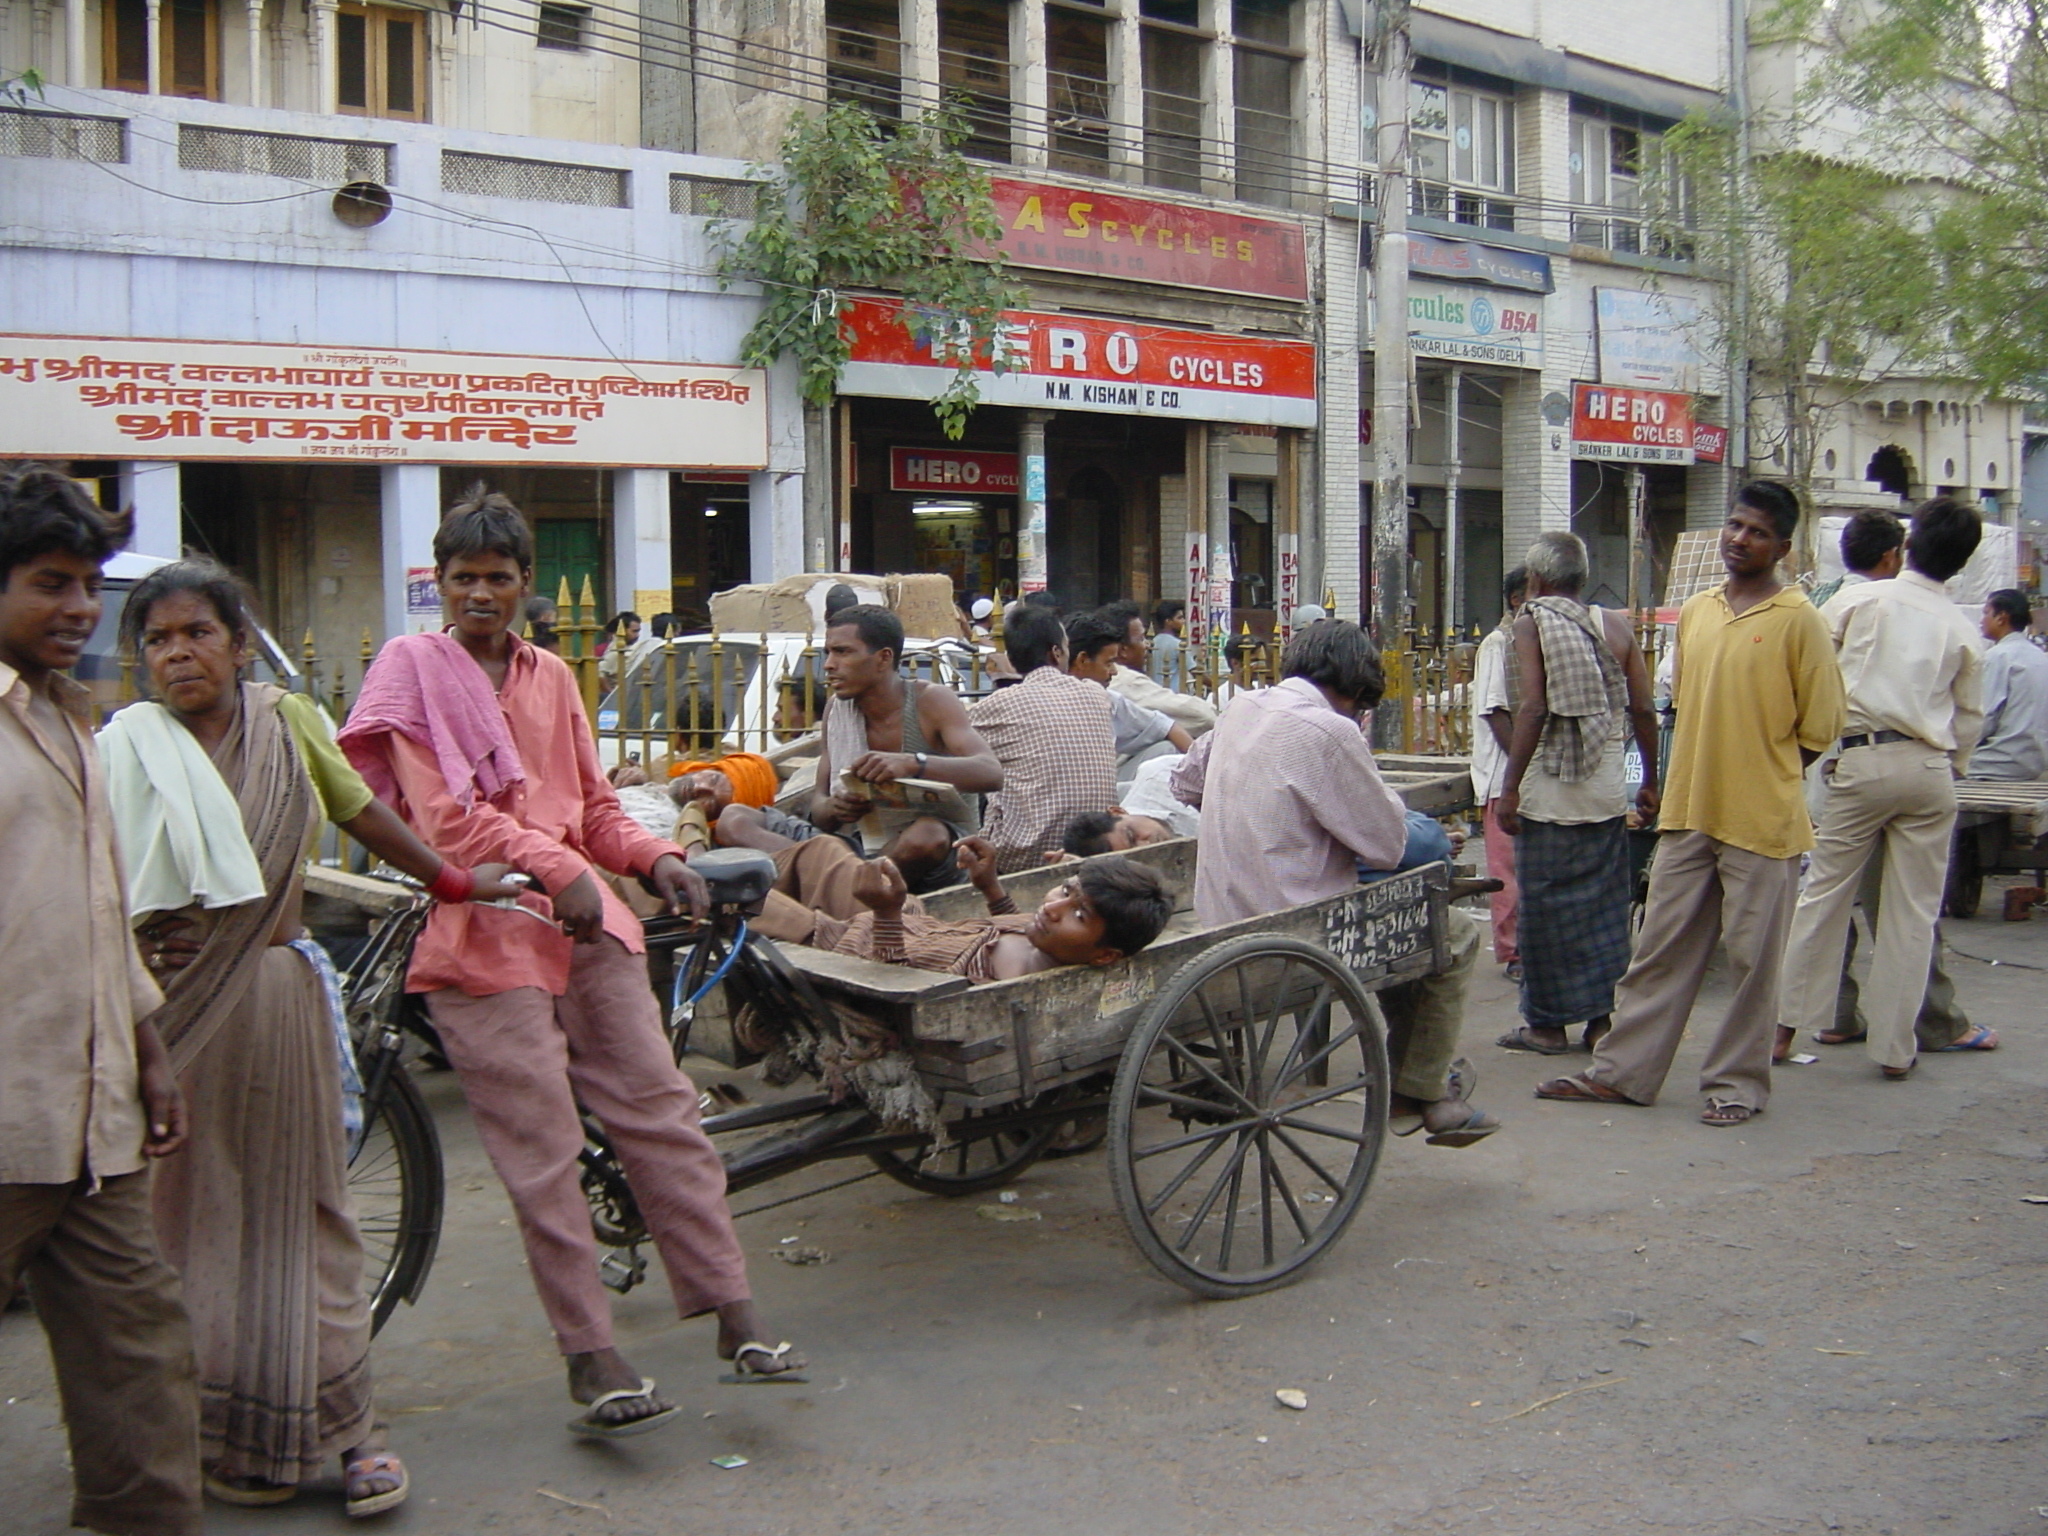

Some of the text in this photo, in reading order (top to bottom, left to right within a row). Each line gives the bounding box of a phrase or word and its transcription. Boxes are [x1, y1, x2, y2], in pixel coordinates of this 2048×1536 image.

[1101, 220, 1253, 262] CYCLES
[1477, 258, 1543, 284] CYCLES
[1408, 295, 1464, 325] rcules
[1500, 309, 1538, 333] BSA
[181, 363, 374, 387] वल्लभाचार्य
[380, 370, 461, 390] चरण
[466, 372, 573, 396] प्रकटित
[1169, 356, 1264, 388] CYCLES
[211, 389, 335, 410] वाल्लभ
[1084, 384, 1137, 406] KISHAN
[1161, 391, 1181, 409] CO.
[1589, 394, 1665, 425] HERO
[115, 410, 577, 449] श्री दाऊजी मन्दिर
[1633, 425, 1684, 444] CYCLES
[907, 458, 981, 484] HERO
[986, 474, 1019, 486] CYCL
[1190, 543, 1200, 645] ATLAS
